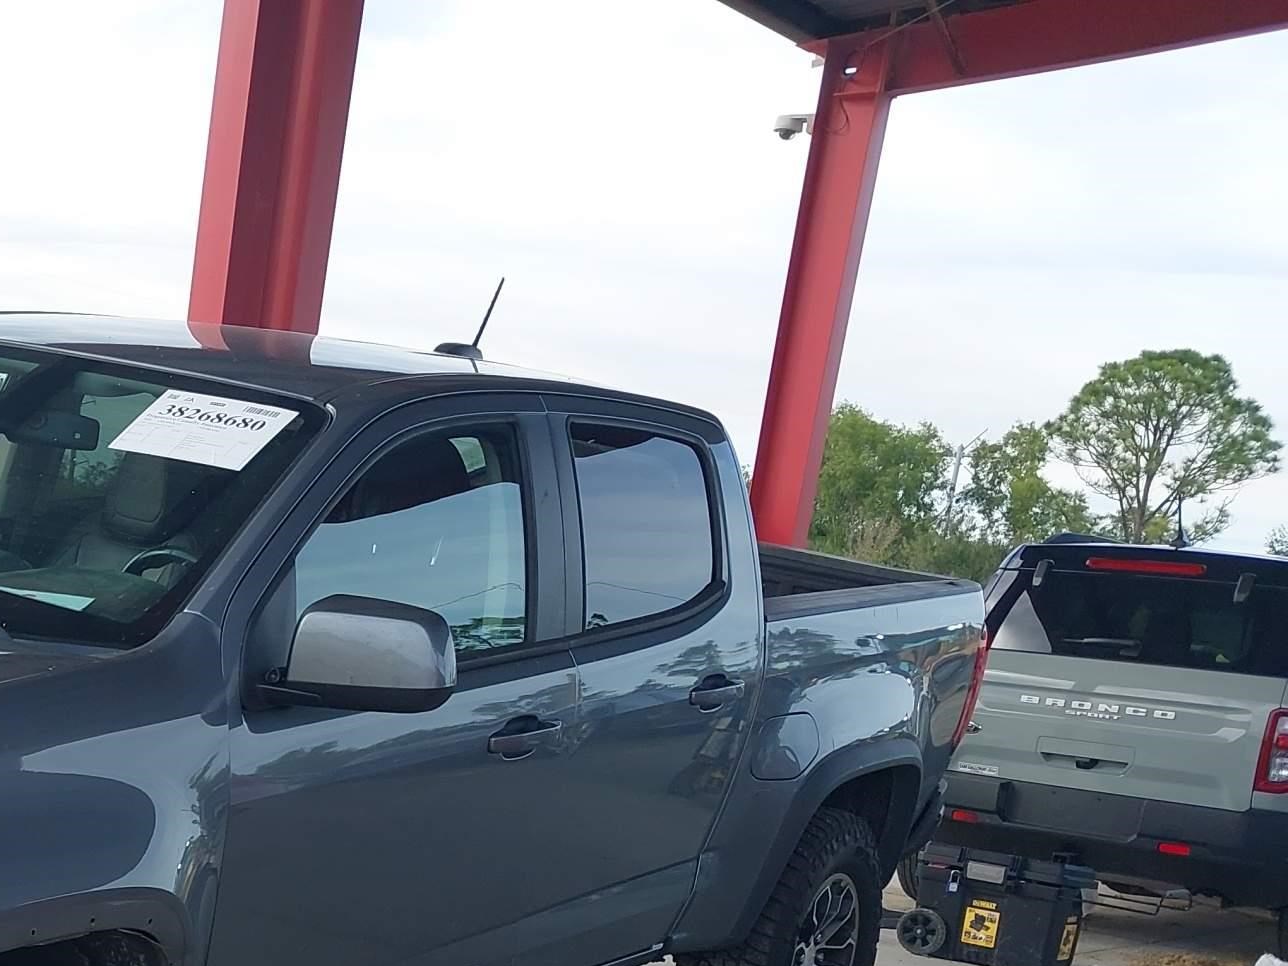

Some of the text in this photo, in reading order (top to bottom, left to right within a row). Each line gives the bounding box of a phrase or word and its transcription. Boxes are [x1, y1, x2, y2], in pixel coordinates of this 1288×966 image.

[159, 404, 266, 431] 38268680
[1020, 694, 1176, 720] BRONCO
[1064, 709, 1122, 720] SPORT
